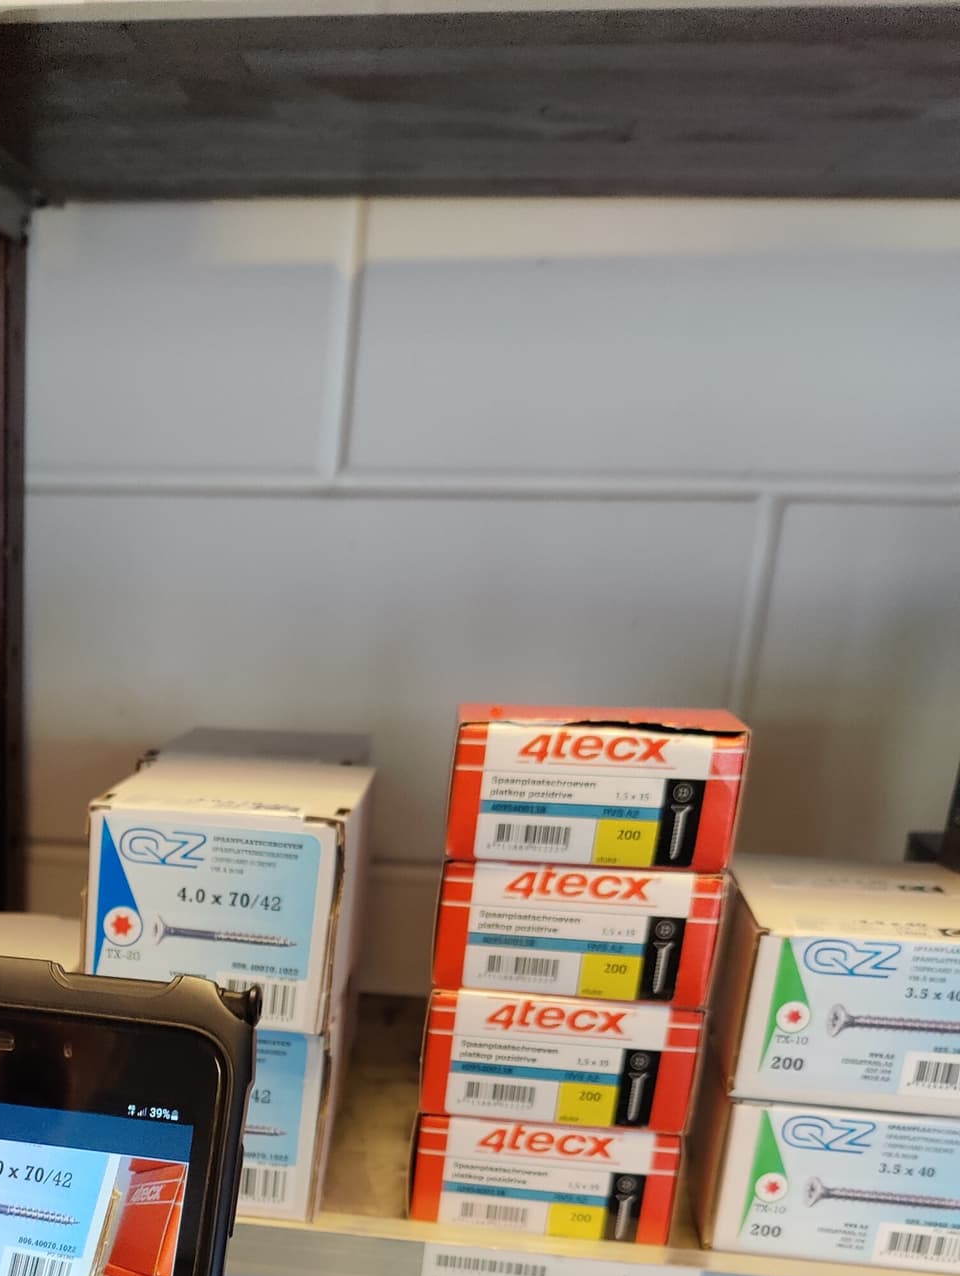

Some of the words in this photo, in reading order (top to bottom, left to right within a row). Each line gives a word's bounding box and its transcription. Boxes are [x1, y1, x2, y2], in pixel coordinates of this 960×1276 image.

[517, 731, 671, 764] 4tecx
[617, 830, 641, 841] 200
[119, 827, 208, 869] QZ
[505, 865, 652, 902] 4tecx
[177, 886, 206, 904] 4.0
[211, 892, 222, 905] x
[229, 891, 283, 912] 70/42
[803, 938, 903, 979] QZ
[604, 963, 628, 975] 200
[905, 986, 929, 999] 3.5
[932, 990, 942, 1001] x
[486, 1000, 627, 1035] 4tecx
[771, 1056, 805, 1072] 200
[579, 1091, 602, 1103] 200
[149, 1107, 171, 1120] 39%
[477, 1124, 614, 1159] 4tecx
[781, 1115, 877, 1155] QZ
[9, 1166, 20, 1179] x
[25, 1165, 73, 1189] 70/42
[878, 1162, 901, 1175] 3.5
[904, 1166, 914, 1176] x
[917, 1166, 936, 1178] 40
[570, 1212, 592, 1223] 200
[750, 1223, 782, 1238] 200
